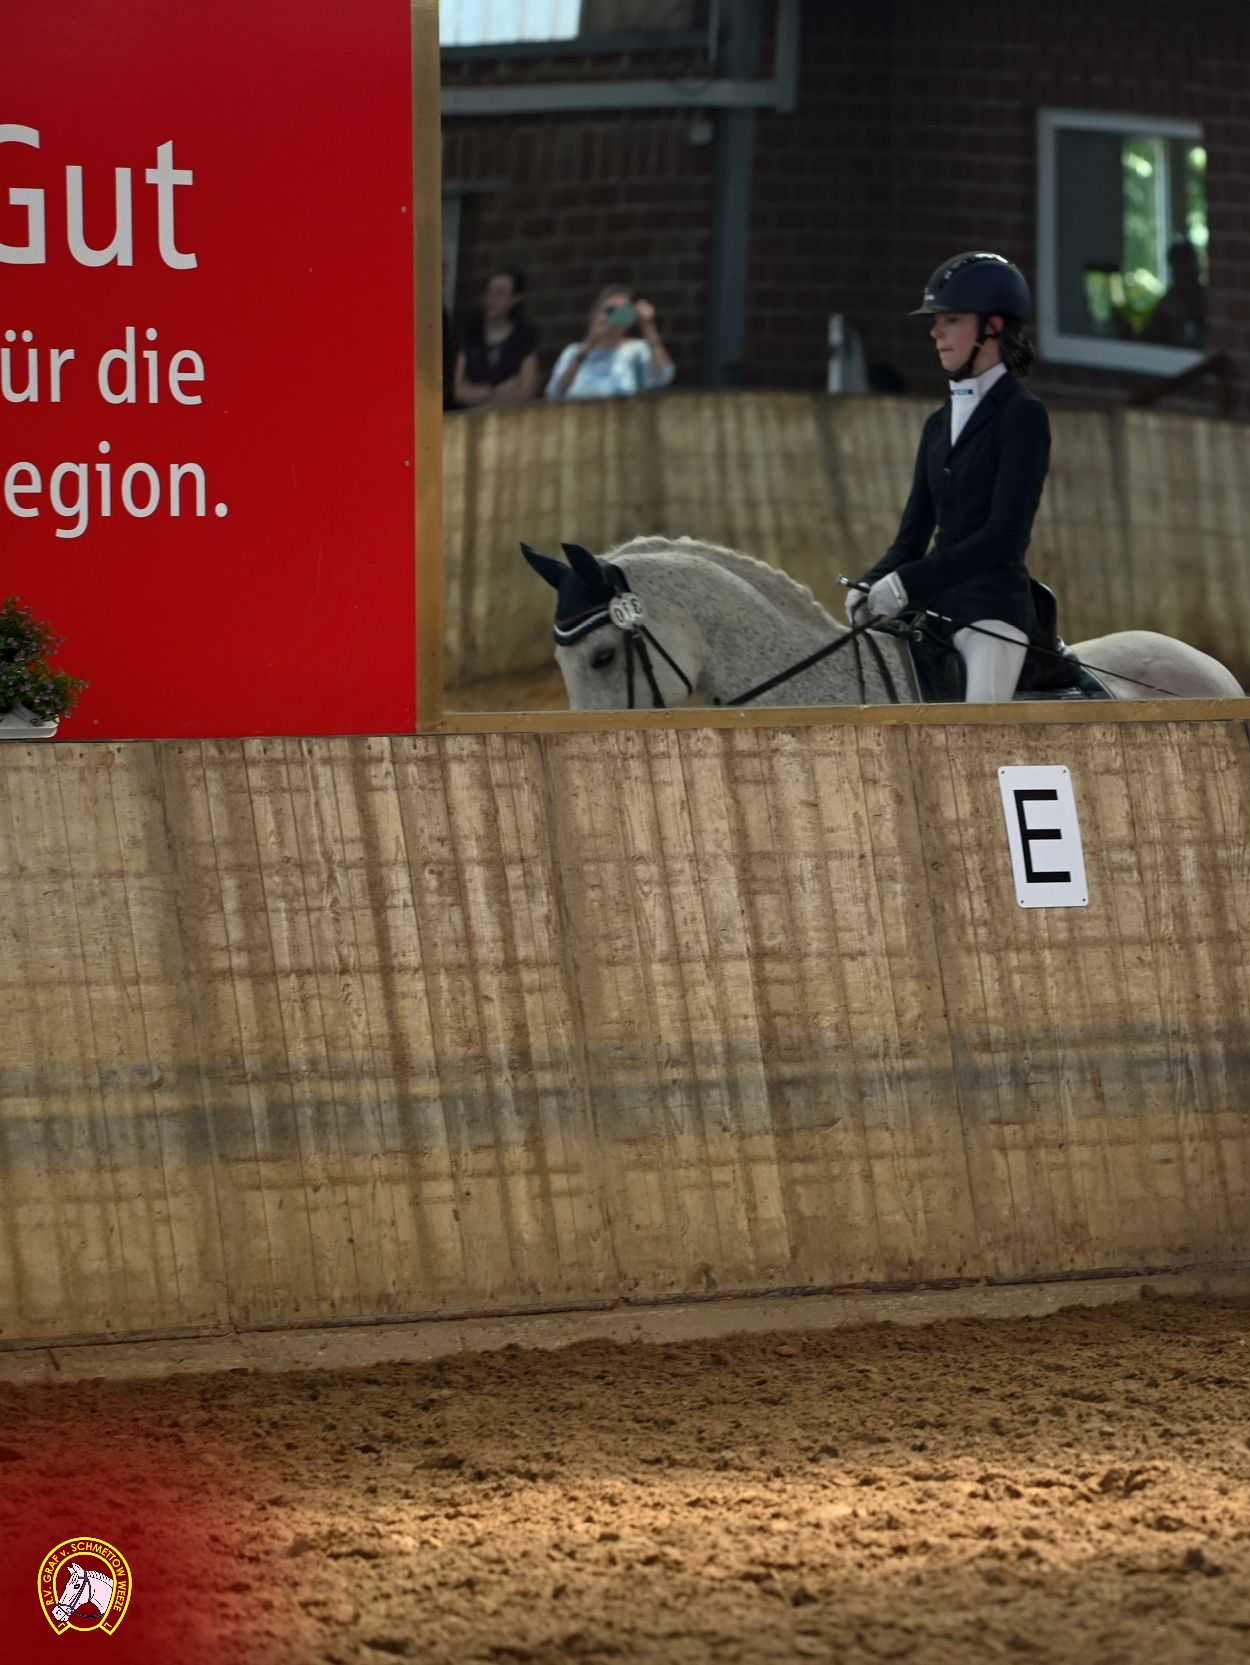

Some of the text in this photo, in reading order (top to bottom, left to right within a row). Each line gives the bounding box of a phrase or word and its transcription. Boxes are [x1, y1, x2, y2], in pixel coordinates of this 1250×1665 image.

[0, 123, 198, 270] Gut
[0, 326, 205, 405] ür die
[3, 440, 228, 538] egion.
[1013, 789, 1071, 883] E
